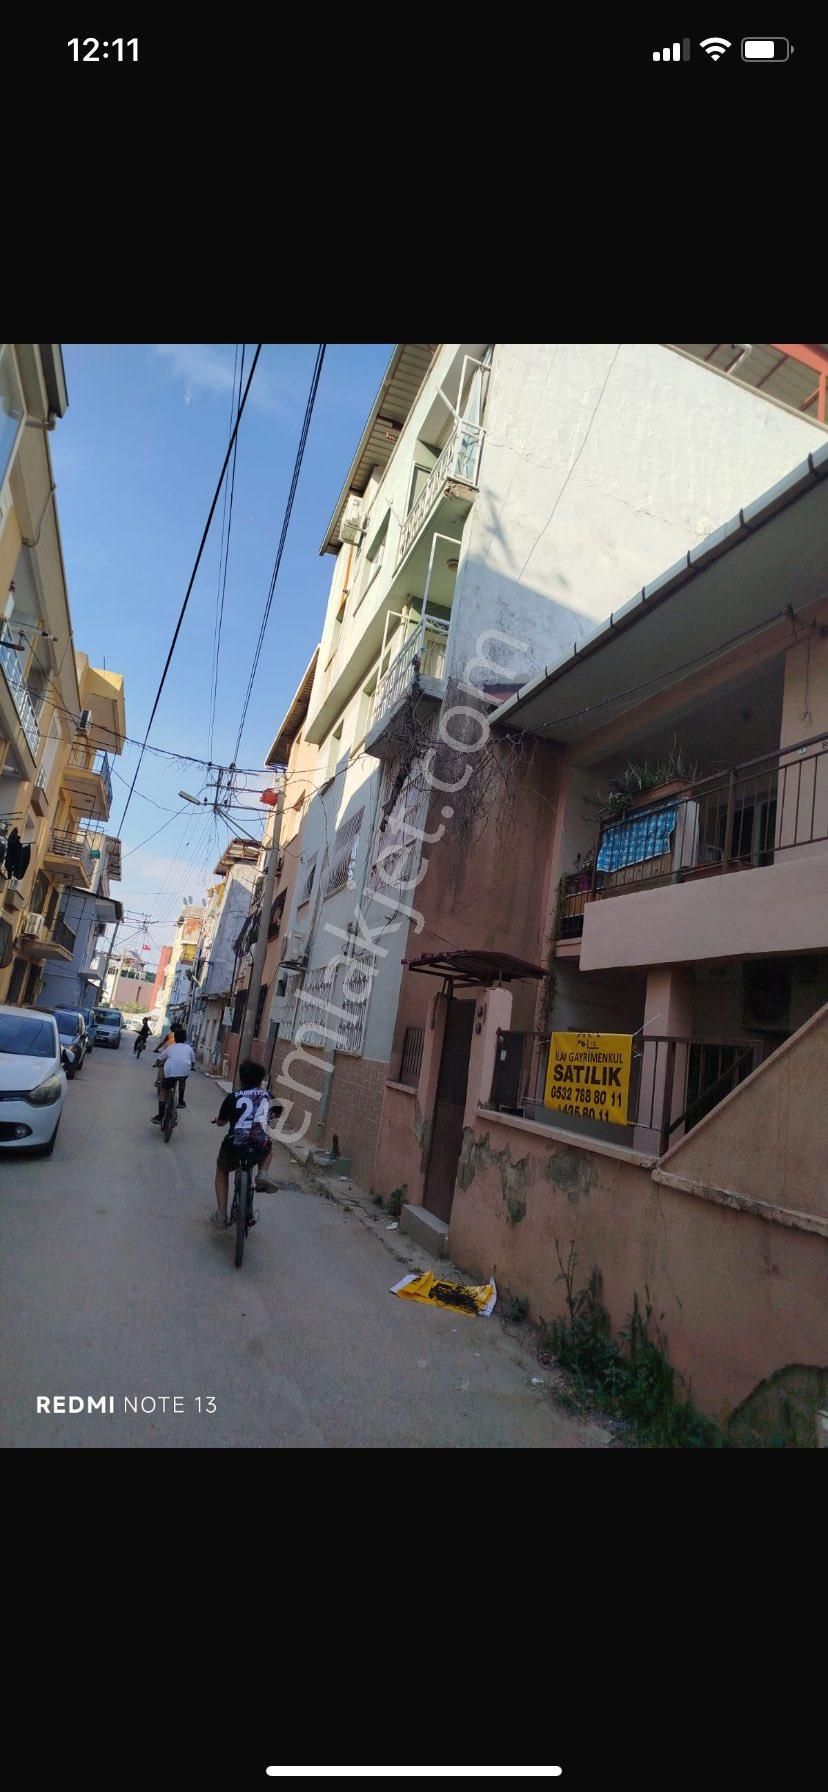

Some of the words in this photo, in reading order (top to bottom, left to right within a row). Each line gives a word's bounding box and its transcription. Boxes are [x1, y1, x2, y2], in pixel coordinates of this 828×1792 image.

[67, 37, 139, 62] 12:11
[568, 1050, 624, 1064] GAYRİMENKUL
[553, 1063, 622, 1087] SATILIK
[551, 1085, 573, 1101] 0532
[594, 1089, 607, 1105] 80
[611, 1091, 622, 1108] 11
[234, 1097, 269, 1129] 24
